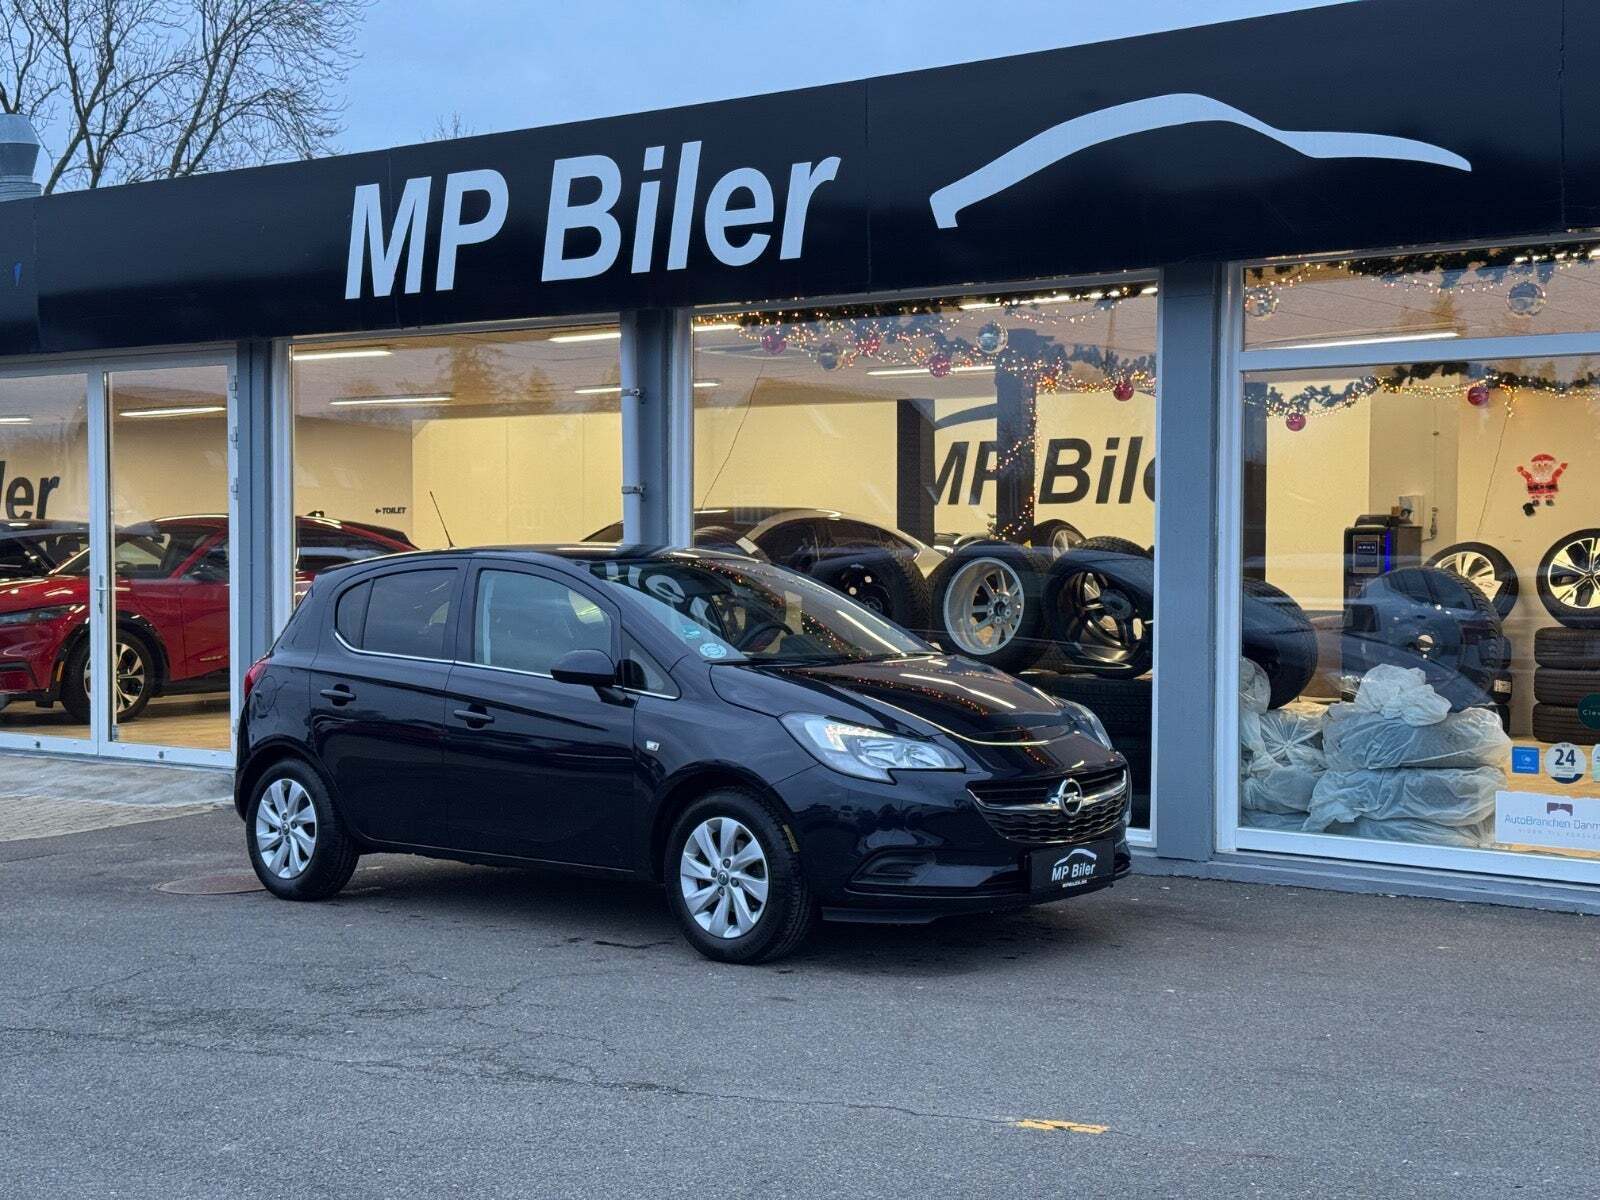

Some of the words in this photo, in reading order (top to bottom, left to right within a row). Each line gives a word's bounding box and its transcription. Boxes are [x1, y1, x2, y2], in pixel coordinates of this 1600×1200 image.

[345, 168, 510, 300] MP
[541, 140, 842, 282] Biler
[1038, 436, 1156, 504] Bil
[382, 506, 407, 514] TOILET
[1554, 748, 1577, 767] 24
[1051, 866, 1069, 881] MP
[1071, 862, 1096, 878] Biler
